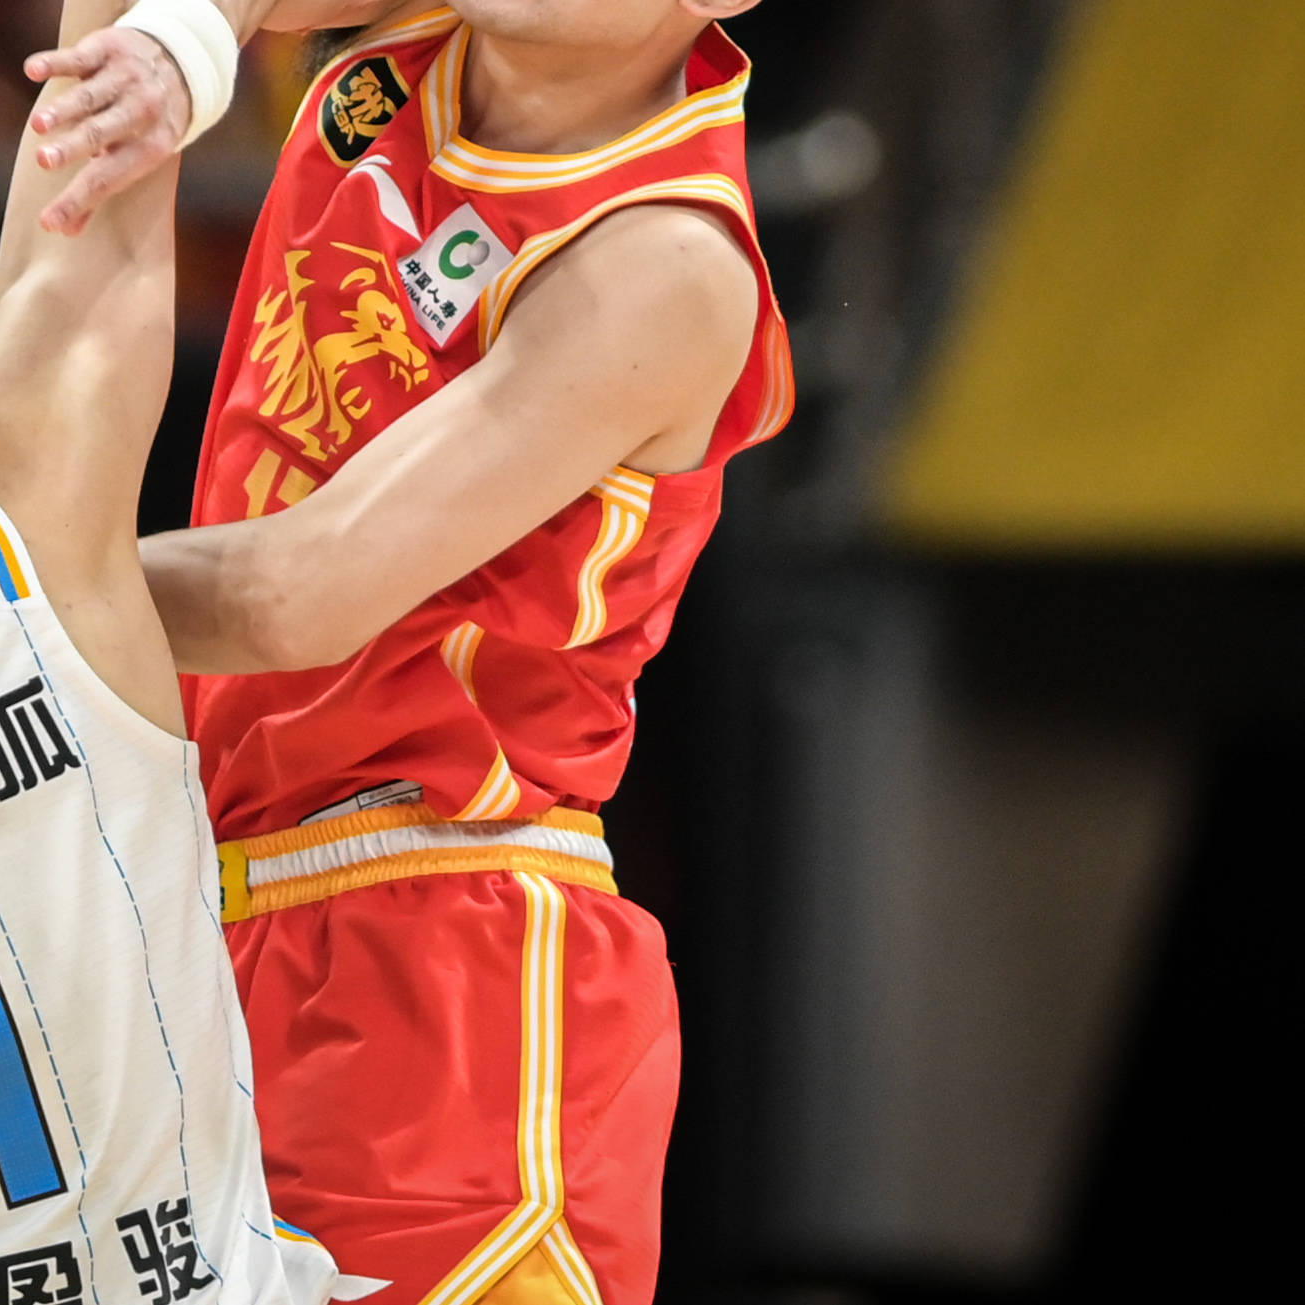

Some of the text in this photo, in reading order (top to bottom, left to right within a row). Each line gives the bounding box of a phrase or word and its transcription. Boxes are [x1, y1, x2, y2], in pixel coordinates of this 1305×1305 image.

[405, 258, 458, 319] 中国人寿
[421, 304, 446, 331] LIFE
